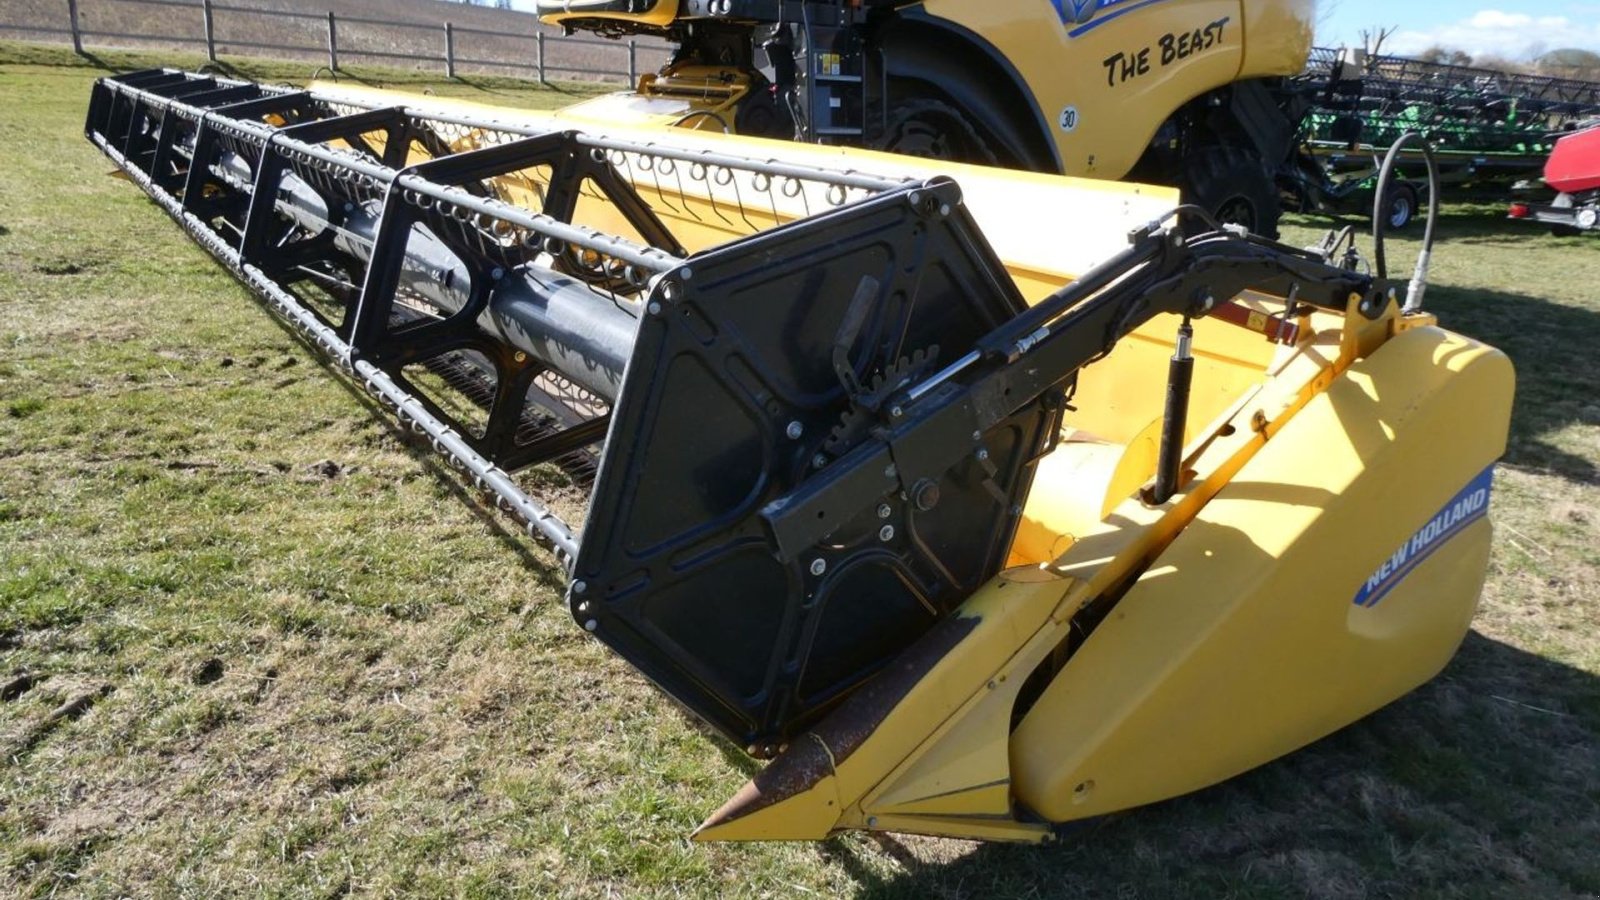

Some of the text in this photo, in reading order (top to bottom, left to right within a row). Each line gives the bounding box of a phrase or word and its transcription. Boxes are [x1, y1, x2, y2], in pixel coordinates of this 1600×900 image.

[1062, 110, 1075, 128] 30
[1367, 488, 1486, 592] NEW HOLLAND
